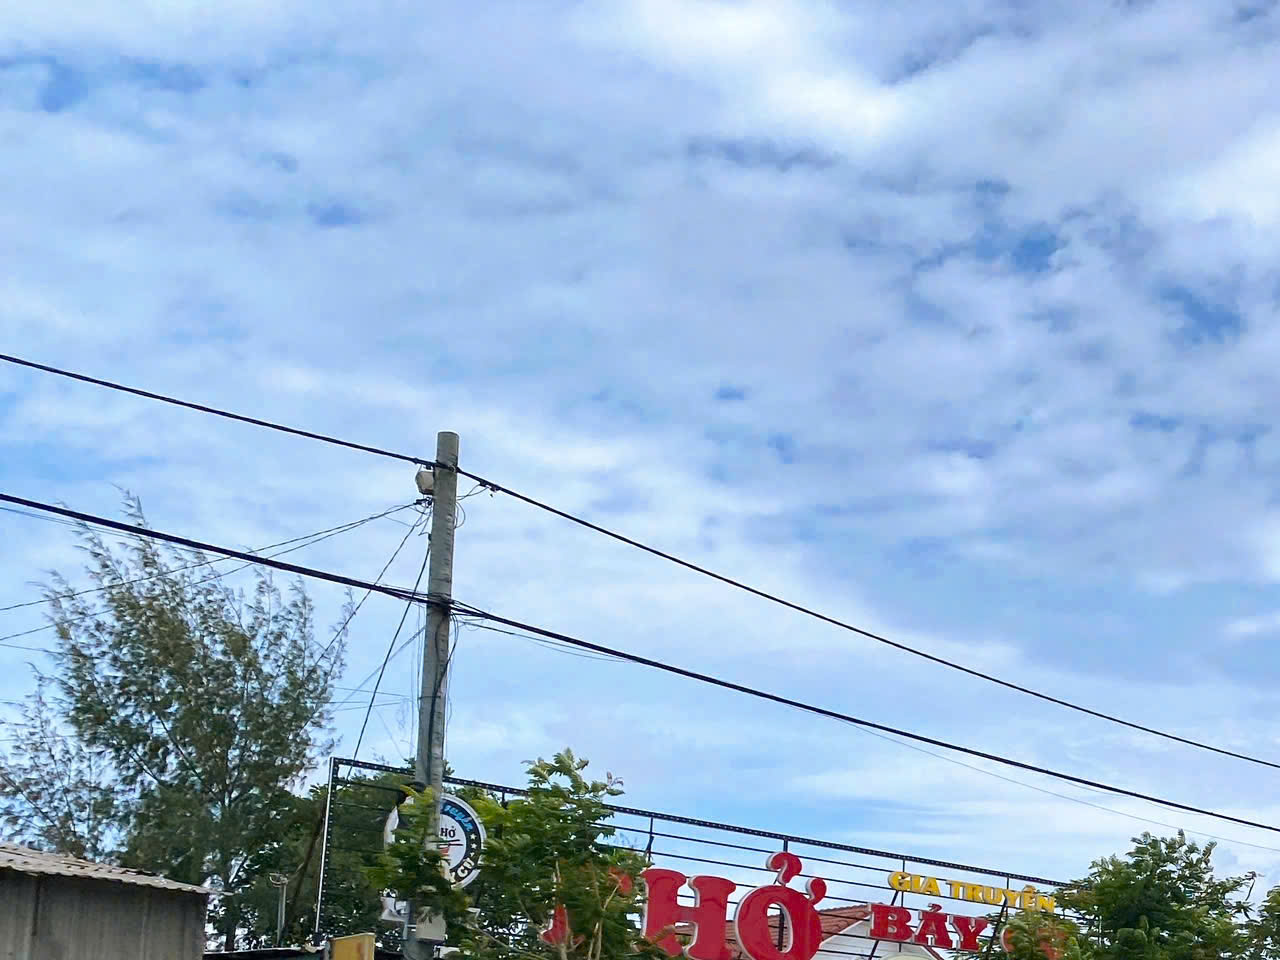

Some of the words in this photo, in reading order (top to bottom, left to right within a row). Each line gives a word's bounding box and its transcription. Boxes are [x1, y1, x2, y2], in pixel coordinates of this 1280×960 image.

[440, 825, 457, 838] HỞ
[888, 871, 942, 896] GIA
[870, 903, 990, 952] BẢY
